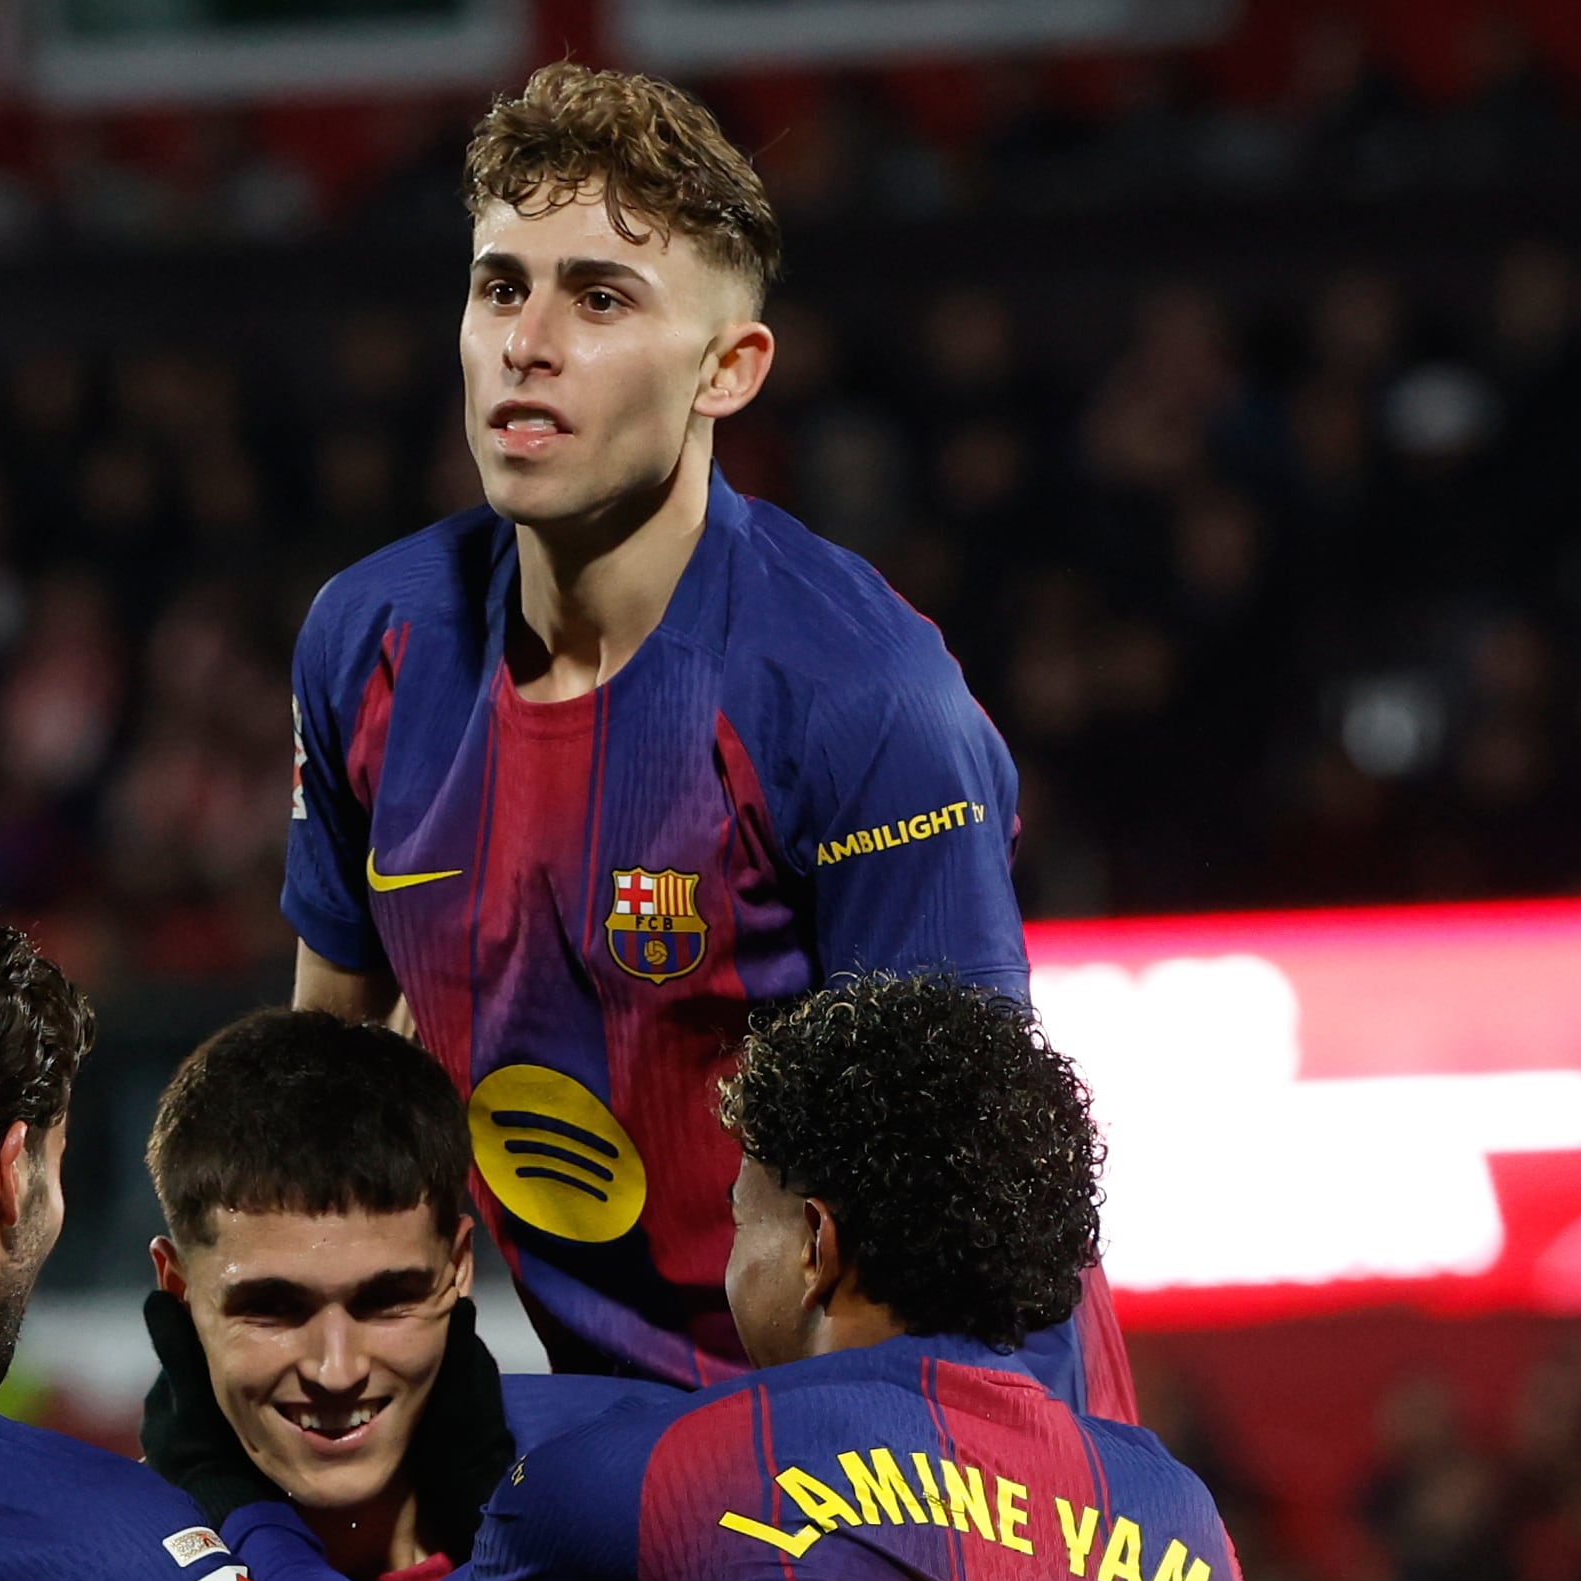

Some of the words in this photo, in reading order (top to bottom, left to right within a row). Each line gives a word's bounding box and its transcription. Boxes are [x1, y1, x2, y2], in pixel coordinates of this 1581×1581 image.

[817, 801, 968, 866] AMBILIGHT
[635, 916, 673, 931] FCB
[718, 1448, 1034, 1559] LAMINE
